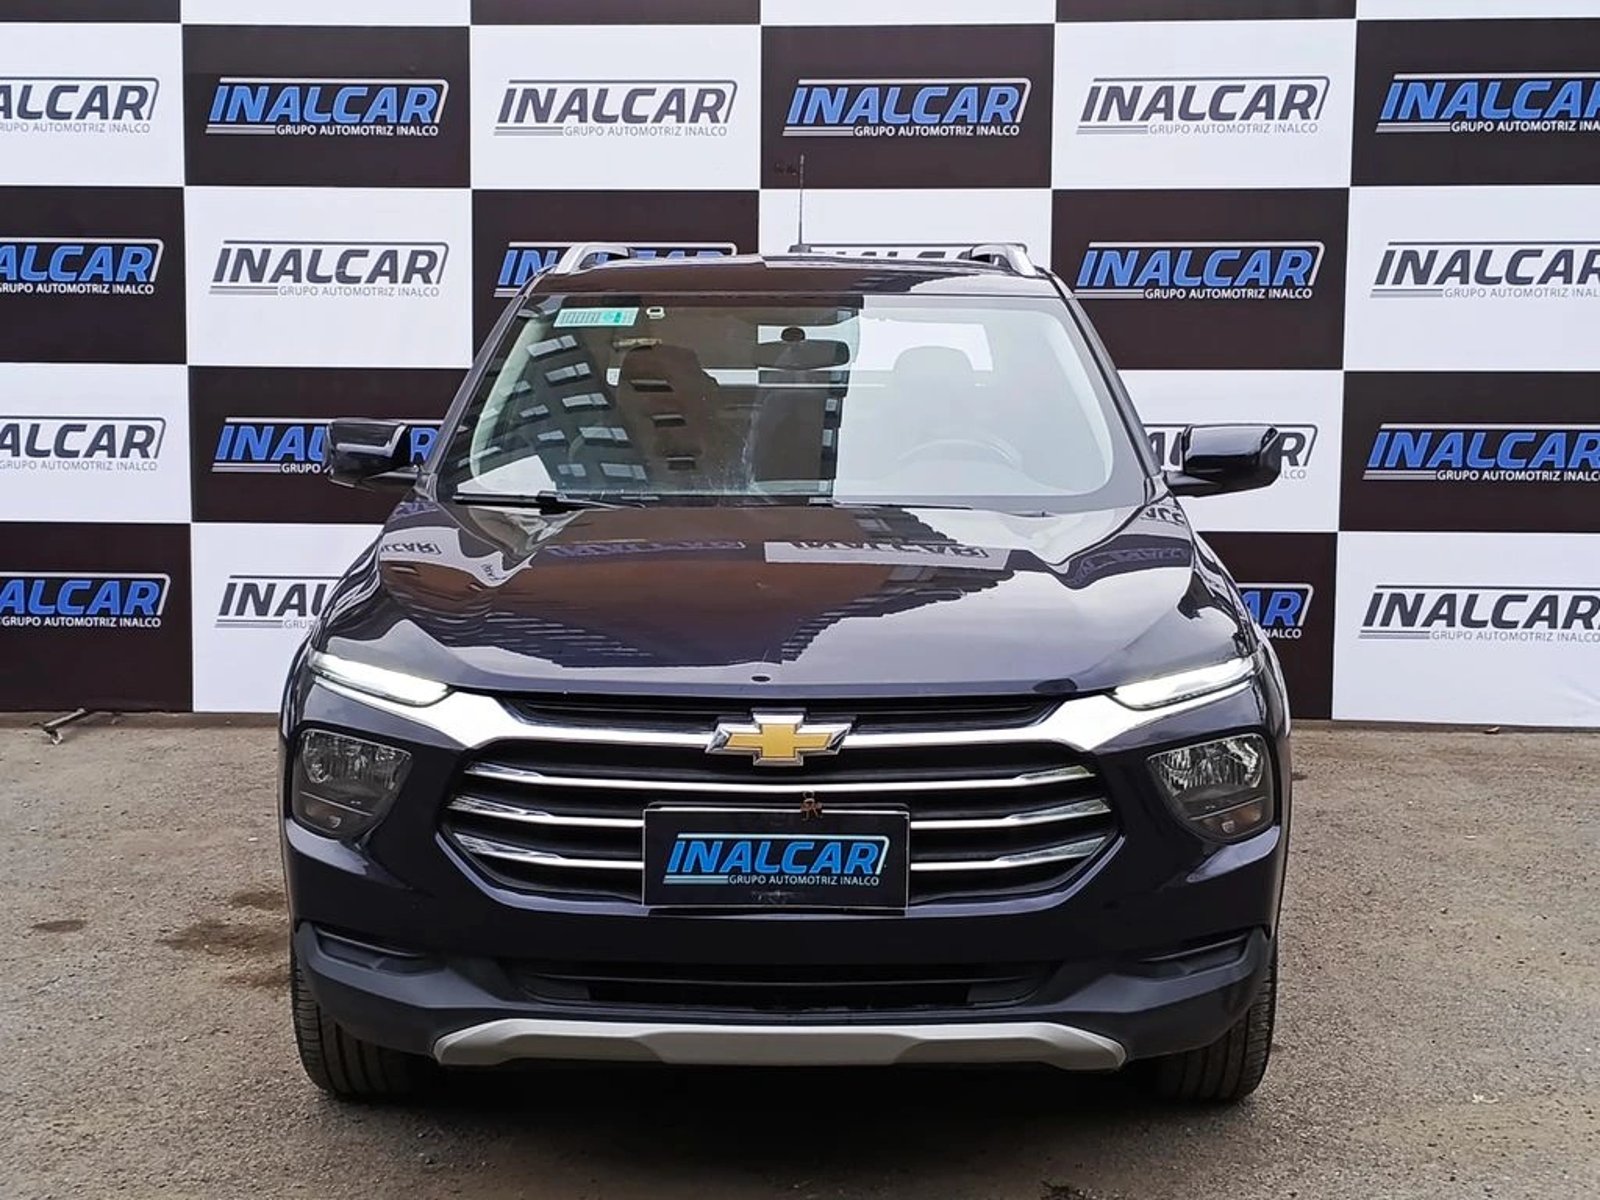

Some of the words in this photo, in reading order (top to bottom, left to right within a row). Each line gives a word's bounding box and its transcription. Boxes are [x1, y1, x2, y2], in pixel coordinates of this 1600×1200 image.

[208, 85, 438, 123] INALCAR
[497, 86, 727, 124] INALCAR
[786, 85, 1019, 124] INALCAR
[1080, 84, 1315, 122] INALCAR
[0, 122, 29, 133] RUPO
[33, 122, 105, 133] AUTOMOTRIZ
[109, 123, 151, 133] INALCO
[276, 125, 317, 136] GRUPO
[319, 125, 393, 136] AUTOMOTRIZ
[396, 125, 439, 137] INALCO
[564, 125, 604, 136] GRUPO
[607, 125, 681, 136] AUTOMOTRIZ
[684, 125, 727, 137] INALCO
[854, 125, 895, 137] GRUPO
[898, 125, 973, 137] AUTOMOTRIZ
[977, 125, 1020, 136] INALCO
[1149, 124, 1191, 135] GRUPO
[1193, 123, 1270, 135] AUTOMOTRIZ
[1274, 123, 1318, 134] INALCO
[1451, 121, 1494, 132] GRUPO
[1496, 120, 1577, 132] AUTOMOTRIZ
[1579, 120, 1600, 131] INA
[0, 245, 152, 282] ALCAR
[213, 248, 439, 284] INALCAR
[1077, 249, 1315, 286] INALCAR
[36, 283, 110, 294] AUTOMOTRIZ
[112, 284, 154, 294] INALCO
[279, 286, 318, 297] GRUPO
[321, 286, 394, 297] AUTOMOTRIZ
[398, 286, 439, 298] INALCO
[1144, 288, 1186, 299] GRUPO
[1189, 288, 1265, 299] AUTOMOTRIZ
[1269, 288, 1313, 299] INALCO
[1444, 287, 1487, 298] GRUPO
[1490, 287, 1568, 298] AUTOMOTRIZ
[1572, 287, 1600, 298] INAL
[0, 423, 155, 459] ALCAR
[1367, 431, 1600, 468] INALCAR
[41, 460, 113, 471] AUTOMOTRIZ
[117, 461, 158, 472] INALCO
[281, 463, 321, 474] GRUPO
[1436, 470, 1479, 481] GRUPO
[1482, 470, 1561, 481] AUTOMOTRIZ
[0, 579, 160, 615] ALCAR
[219, 582, 328, 617] INAL
[1362, 592, 1600, 630] INALCAR
[2, 616, 41, 626] GRUPO
[44, 616, 117, 627] AUTOMOTRIZ
[120, 617, 161, 628] INALCO
[1262, 628, 1302, 638] NALCO
[1432, 630, 1473, 640] GRUPO
[1476, 630, 1554, 642] AUTOMOTRIZ
[666, 841, 880, 875] INALCAR
[729, 875, 766, 886] GRUPO
[769, 875, 838, 886] AUTOMOTRIZ
[840, 876, 880, 887] INALCO
